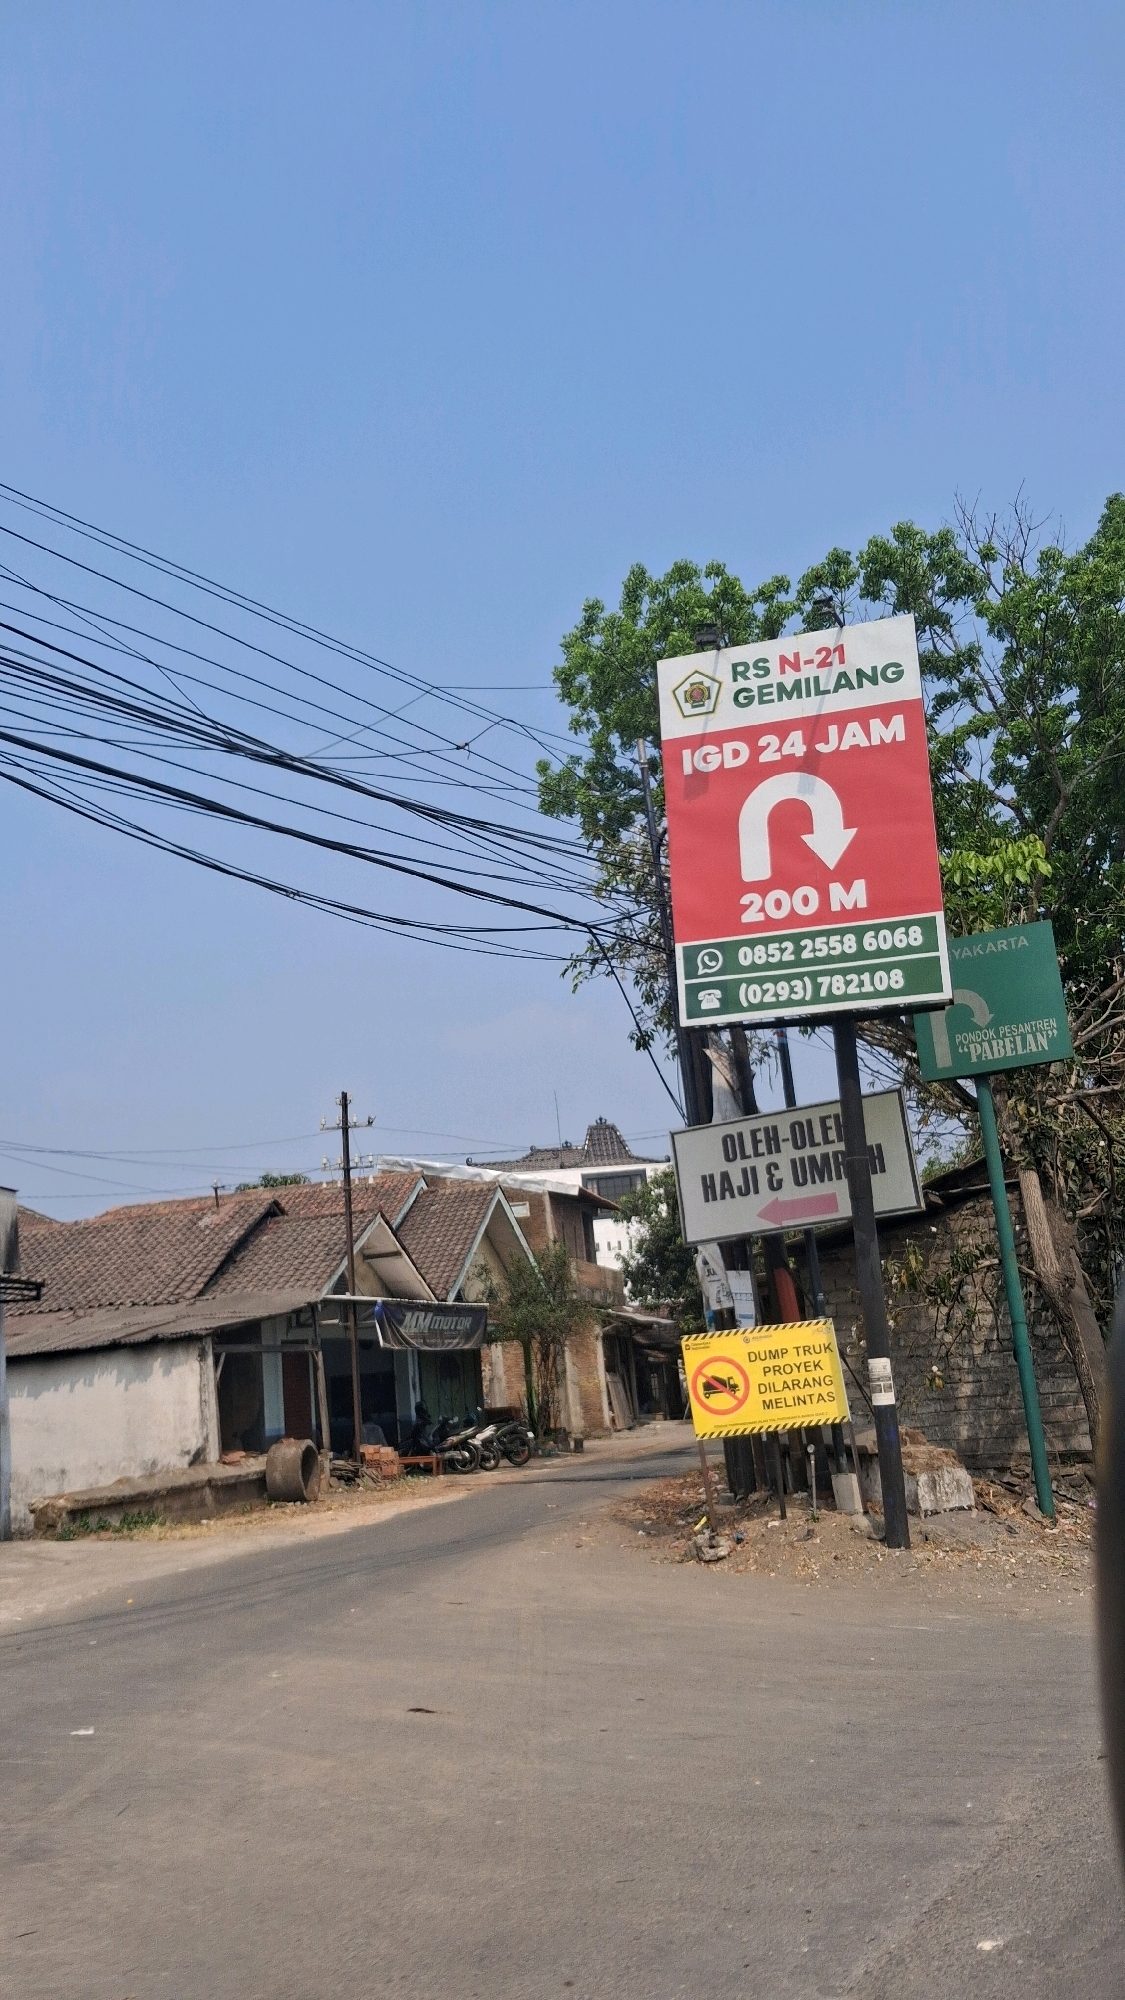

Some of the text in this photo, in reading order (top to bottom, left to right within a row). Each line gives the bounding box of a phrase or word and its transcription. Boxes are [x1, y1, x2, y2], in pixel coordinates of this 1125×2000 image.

[731, 643, 846, 683] RS N-21
[732, 662, 905, 709] GEMILANG
[682, 714, 906, 775] IGD 24 JAM
[739, 878, 868, 923] 200 M
[738, 925, 923, 966] 0852 2558 6068
[949, 935, 1029, 961] YAKARTA
[739, 968, 905, 1007] (0293) 782108
[955, 1017, 1057, 1046] PONDOK PESANTREN
[701, 1143, 886, 1203] HAJI & UMRH
[747, 1341, 834, 1363] DUMP TRUK
[762, 1359, 824, 1377] PROYEK
[757, 1374, 834, 1395] DILARANG
[762, 1391, 836, 1411] MELINTAS
